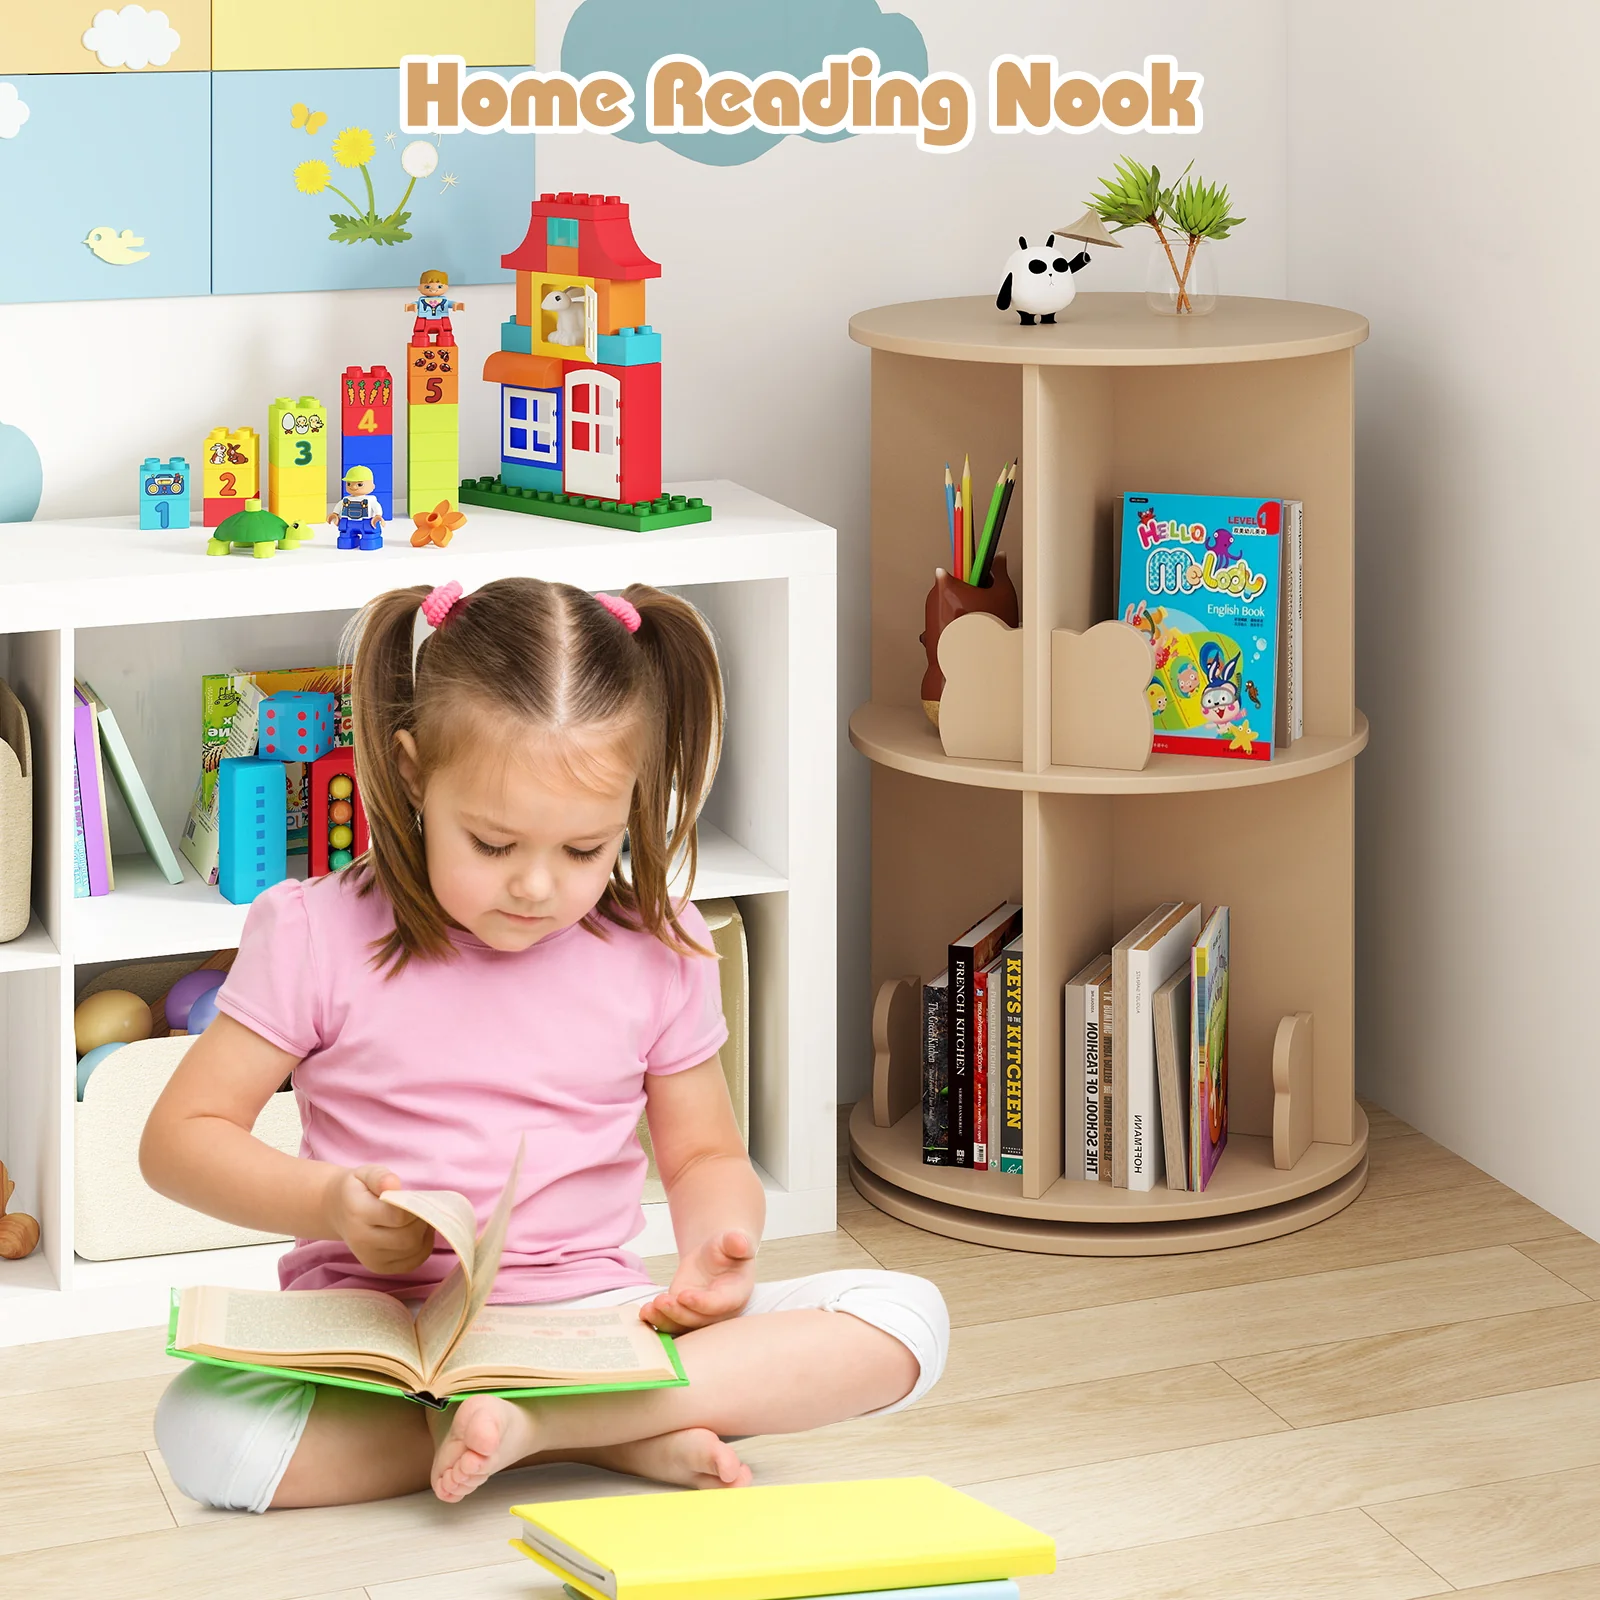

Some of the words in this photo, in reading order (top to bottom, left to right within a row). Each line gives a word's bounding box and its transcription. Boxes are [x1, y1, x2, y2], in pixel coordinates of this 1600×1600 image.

[425, 377, 443, 403] 5
[357, 408, 378, 433] 4
[294, 440, 313, 466] 3
[218, 472, 237, 497] 2
[154, 501, 170, 529] 1
[1227, 515, 1257, 526] LEVEL
[1258, 511, 1268, 527] 1
[1138, 520, 1206, 550] HELLO
[1207, 603, 1240, 618] English
[1241, 606, 1265, 617] Book
[956, 960, 965, 1013] FRENCH
[1006, 958, 1022, 1014] KEYS
[928, 1002, 939, 1015] The
[928, 1016, 939, 1036] Green
[928, 1037, 940, 1063] Kitchen
[956, 1017, 965, 1076] KITCHEN
[1006, 1024, 1022, 1130] KITCHEN
